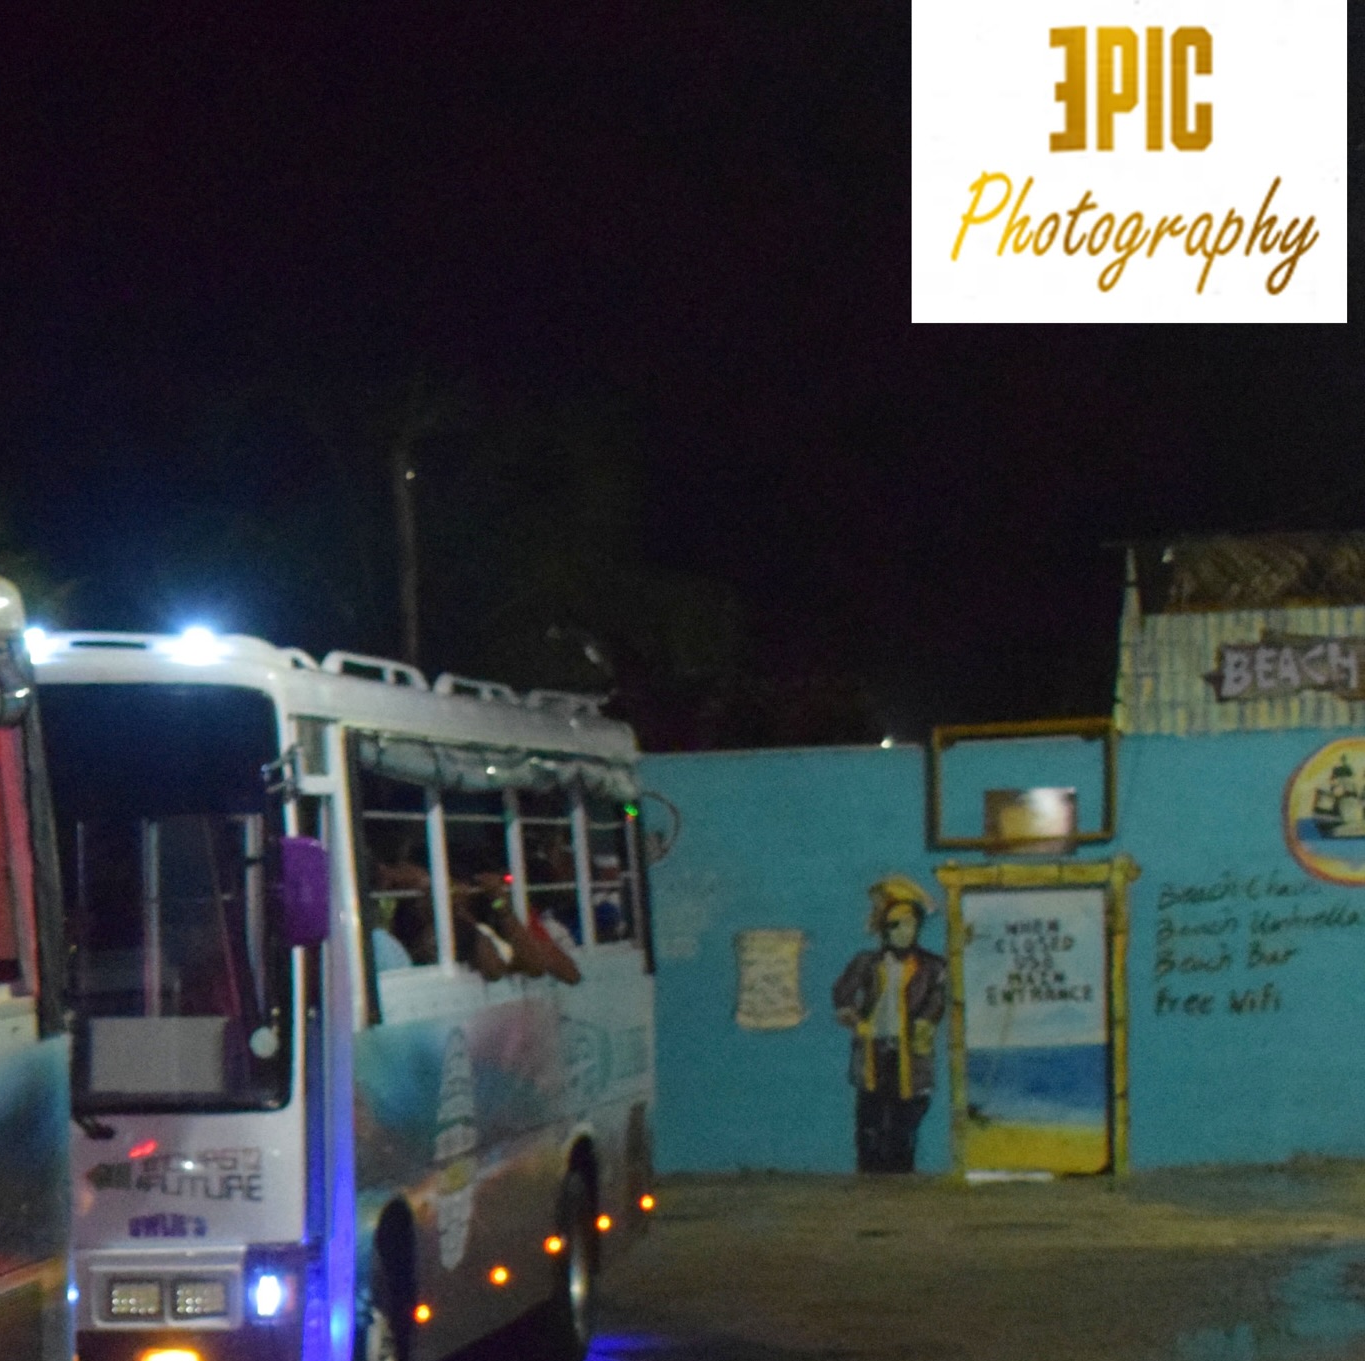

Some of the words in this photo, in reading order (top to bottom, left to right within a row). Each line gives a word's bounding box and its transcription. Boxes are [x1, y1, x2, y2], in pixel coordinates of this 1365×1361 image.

[1219, 641, 1359, 697] BEACH
[995, 935, 1075, 954] CLOSED
[1008, 971, 1066, 987] MAIN
[985, 984, 1093, 1006] ENTRANCE
[1154, 985, 1214, 1017] Free
